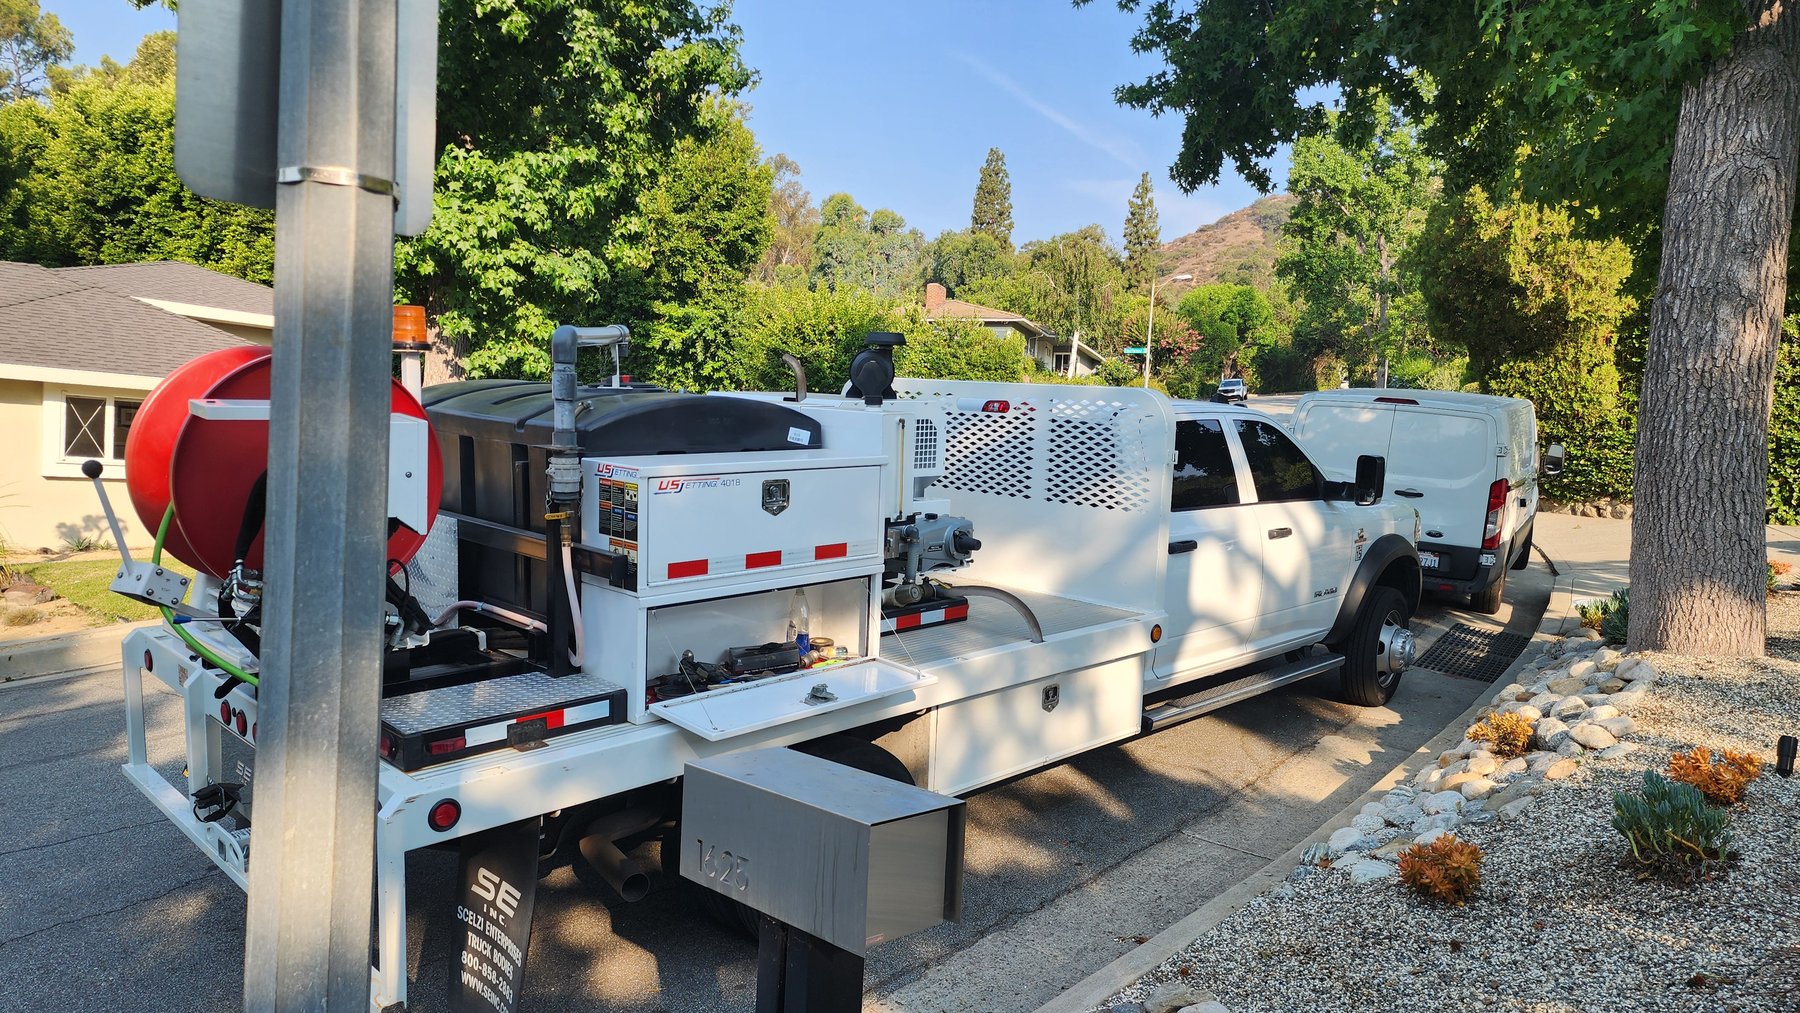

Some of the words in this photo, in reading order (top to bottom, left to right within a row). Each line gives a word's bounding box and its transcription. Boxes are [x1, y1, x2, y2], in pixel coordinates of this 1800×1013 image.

[1313, 586, 1338, 598] RAM
[697, 838, 750, 891] 1625
[471, 866, 522, 918] SE
[457, 905, 485, 932] SCELZI
[485, 920, 522, 968] ENTERPRISES
[467, 931, 493, 960] TRUCK
[493, 948, 514, 981] BODIES
[461, 950, 513, 1005] 800-858-2883
